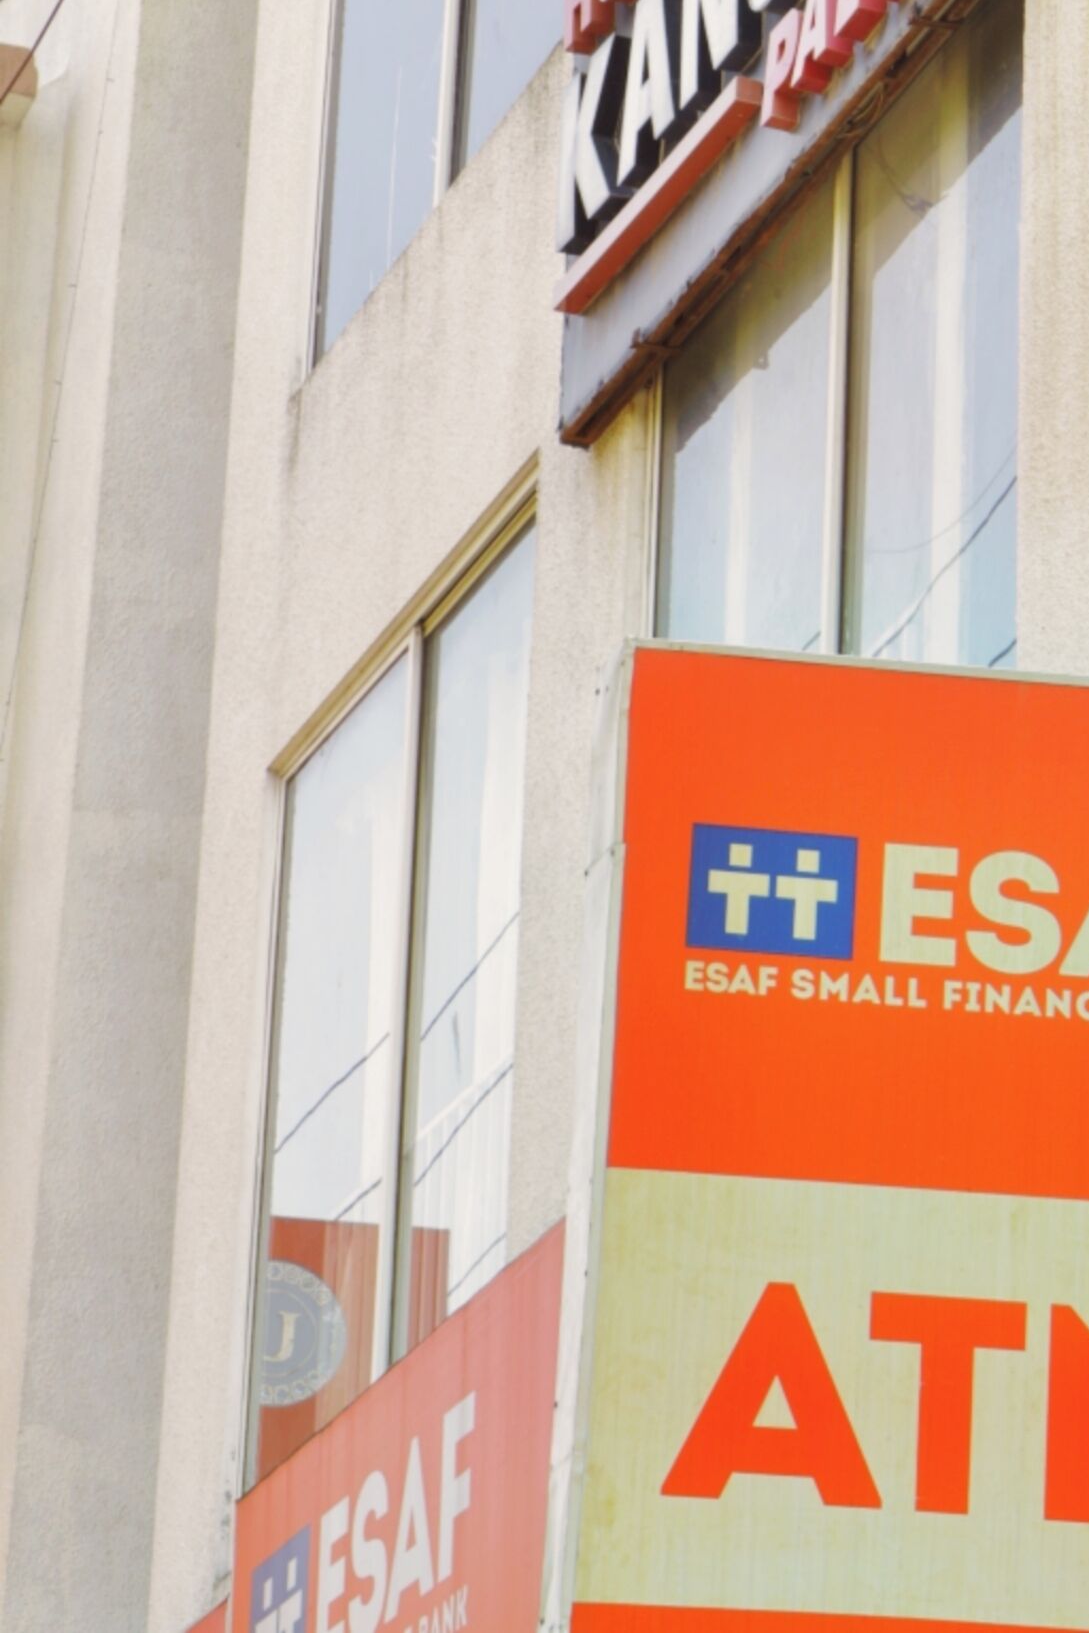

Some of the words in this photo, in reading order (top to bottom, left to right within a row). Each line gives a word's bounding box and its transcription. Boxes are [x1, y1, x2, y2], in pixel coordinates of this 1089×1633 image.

[684, 960, 778, 996] ESAF
[790, 968, 927, 1009] SMALL
[316, 1390, 477, 1633] ESAF
